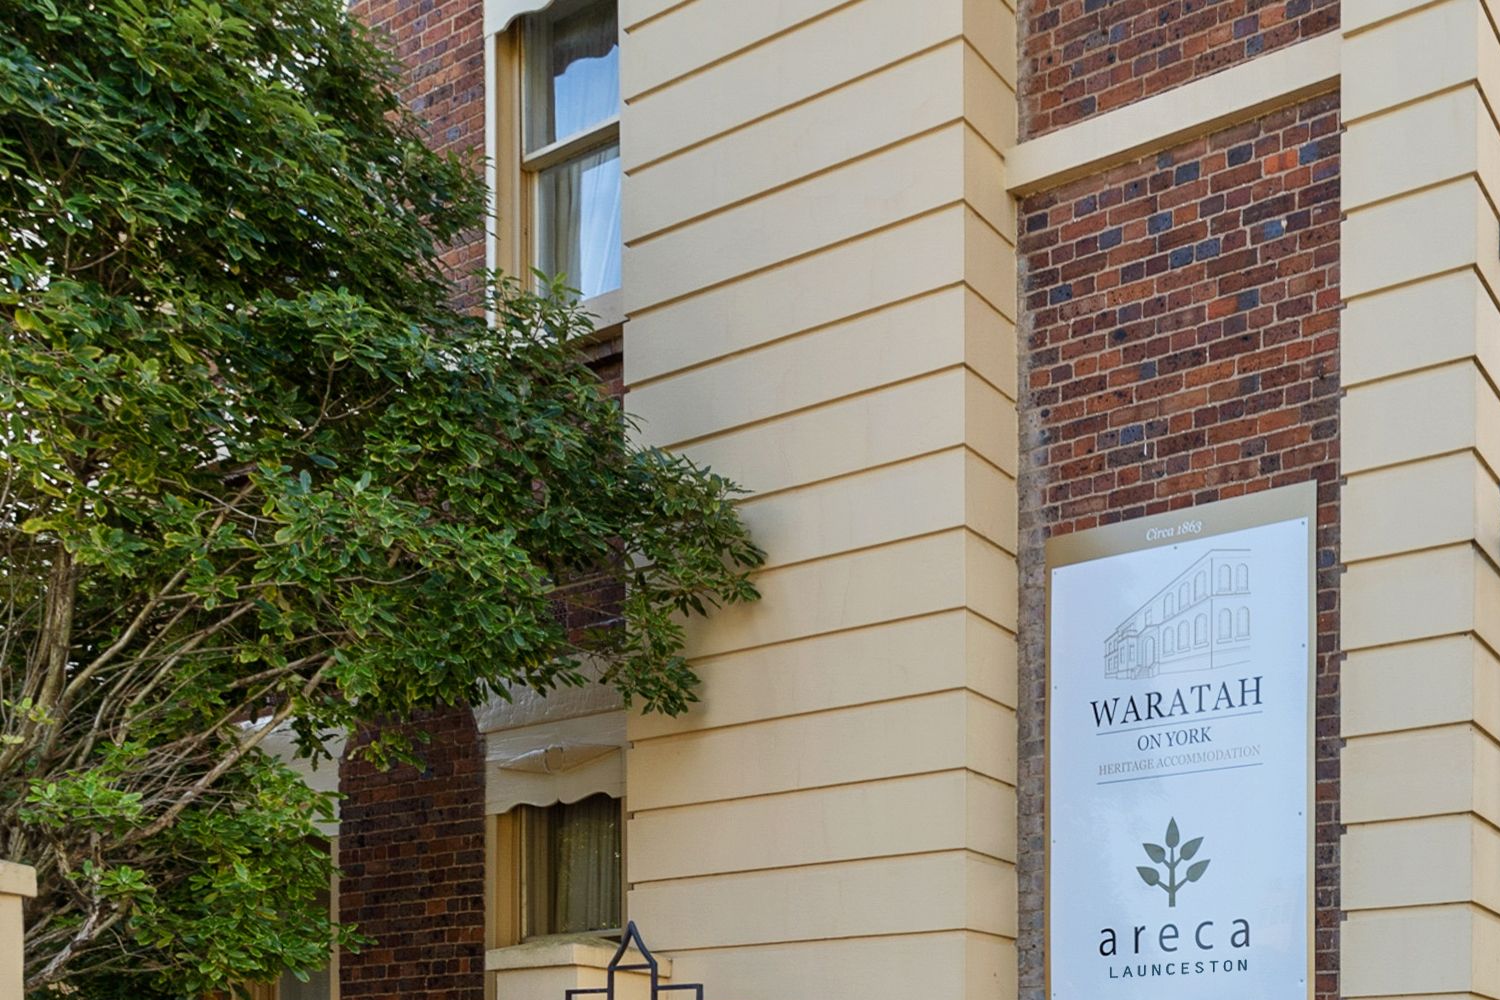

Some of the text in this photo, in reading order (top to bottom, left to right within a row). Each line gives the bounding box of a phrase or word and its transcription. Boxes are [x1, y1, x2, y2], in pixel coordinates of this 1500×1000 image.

[1146, 520, 1202, 541] Circa 1863
[1090, 676, 1263, 728] WARATAH
[1137, 726, 1212, 751] ON YORK
[1099, 744, 1262, 776] HERITAGE ACCOMMODATION
[1099, 918, 1251, 956] areca
[1109, 959, 1248, 979] LAUNCESTON
